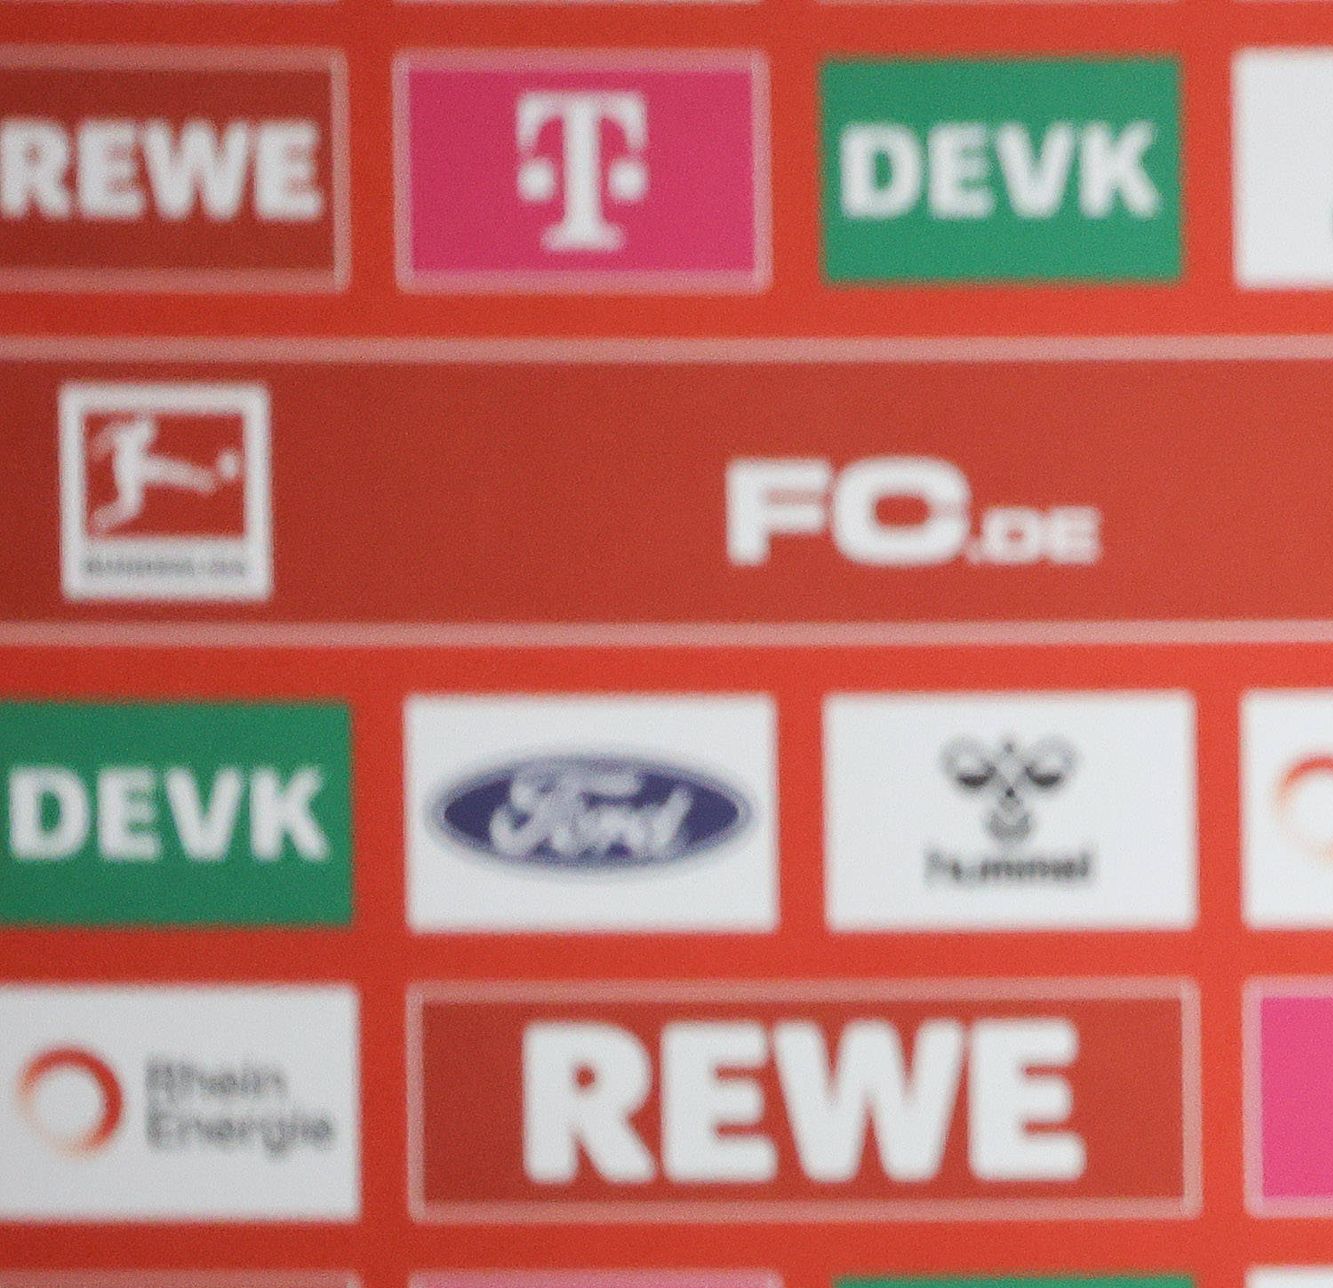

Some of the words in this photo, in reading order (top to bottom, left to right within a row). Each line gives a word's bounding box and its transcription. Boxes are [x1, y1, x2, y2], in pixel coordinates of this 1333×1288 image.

[0, 121, 322, 220] REWE
[841, 122, 1159, 218] DEVK
[726, 457, 1099, 566] FC.DE
[9, 768, 327, 860] DEVK
[488, 763, 695, 865] Ford
[523, 1018, 1085, 1182] REWE
